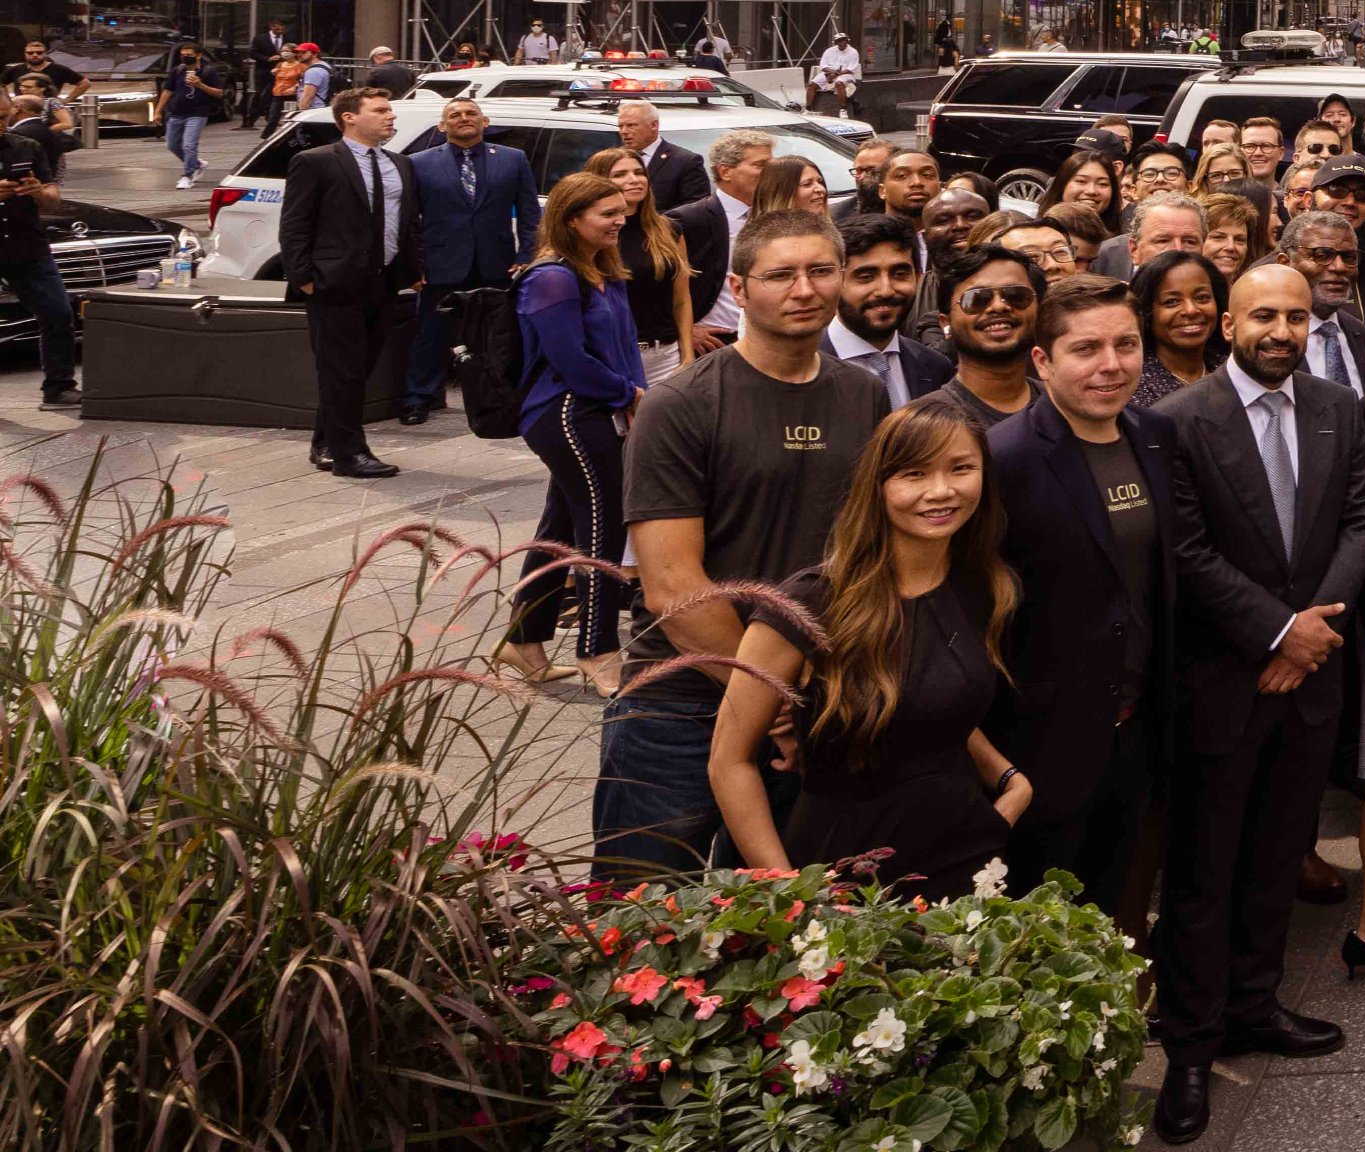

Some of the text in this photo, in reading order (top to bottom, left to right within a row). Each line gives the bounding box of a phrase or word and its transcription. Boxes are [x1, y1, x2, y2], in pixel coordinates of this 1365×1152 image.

[785, 426, 821, 441] LCID
[805, 442, 827, 450] Listed
[1108, 483, 1140, 502] LCID
[1108, 498, 1148, 512] Nasdaq Listed
